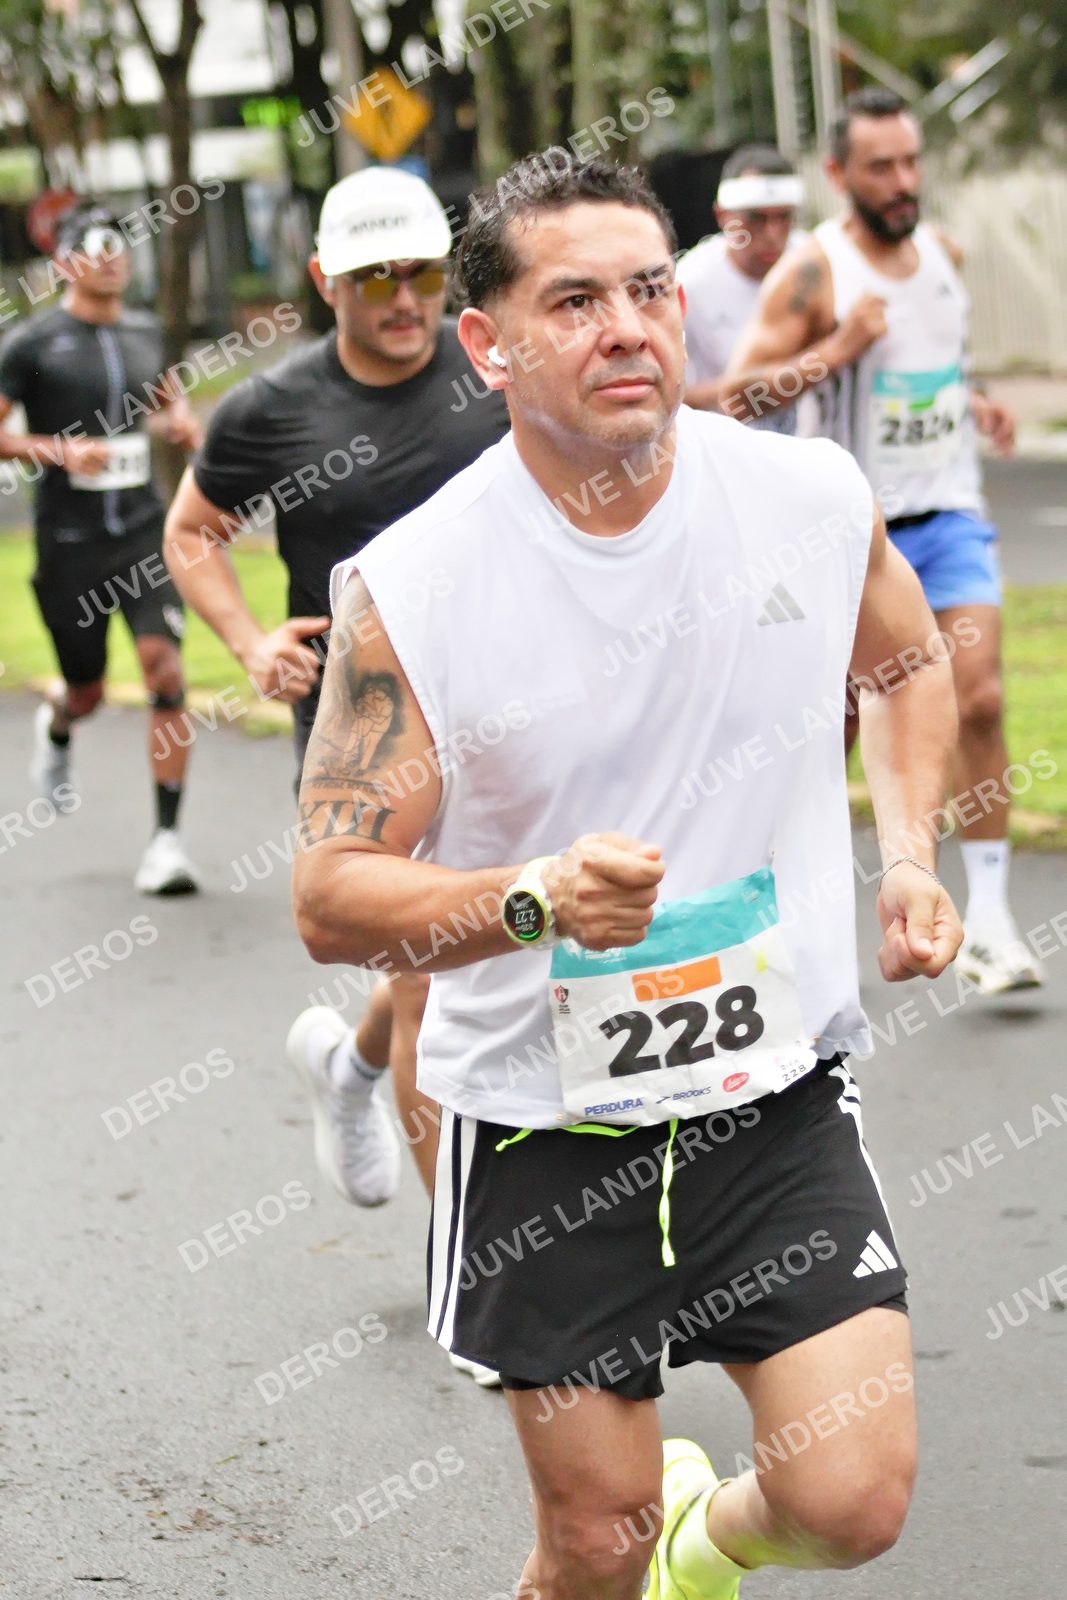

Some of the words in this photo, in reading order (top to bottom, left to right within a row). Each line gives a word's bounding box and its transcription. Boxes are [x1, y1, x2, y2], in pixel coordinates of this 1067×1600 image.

[599, 985, 764, 1078] 228
[781, 1064, 807, 1083] 228
[672, 1086, 712, 1100] BROOKS
[584, 1097, 644, 1116] PERDURA
